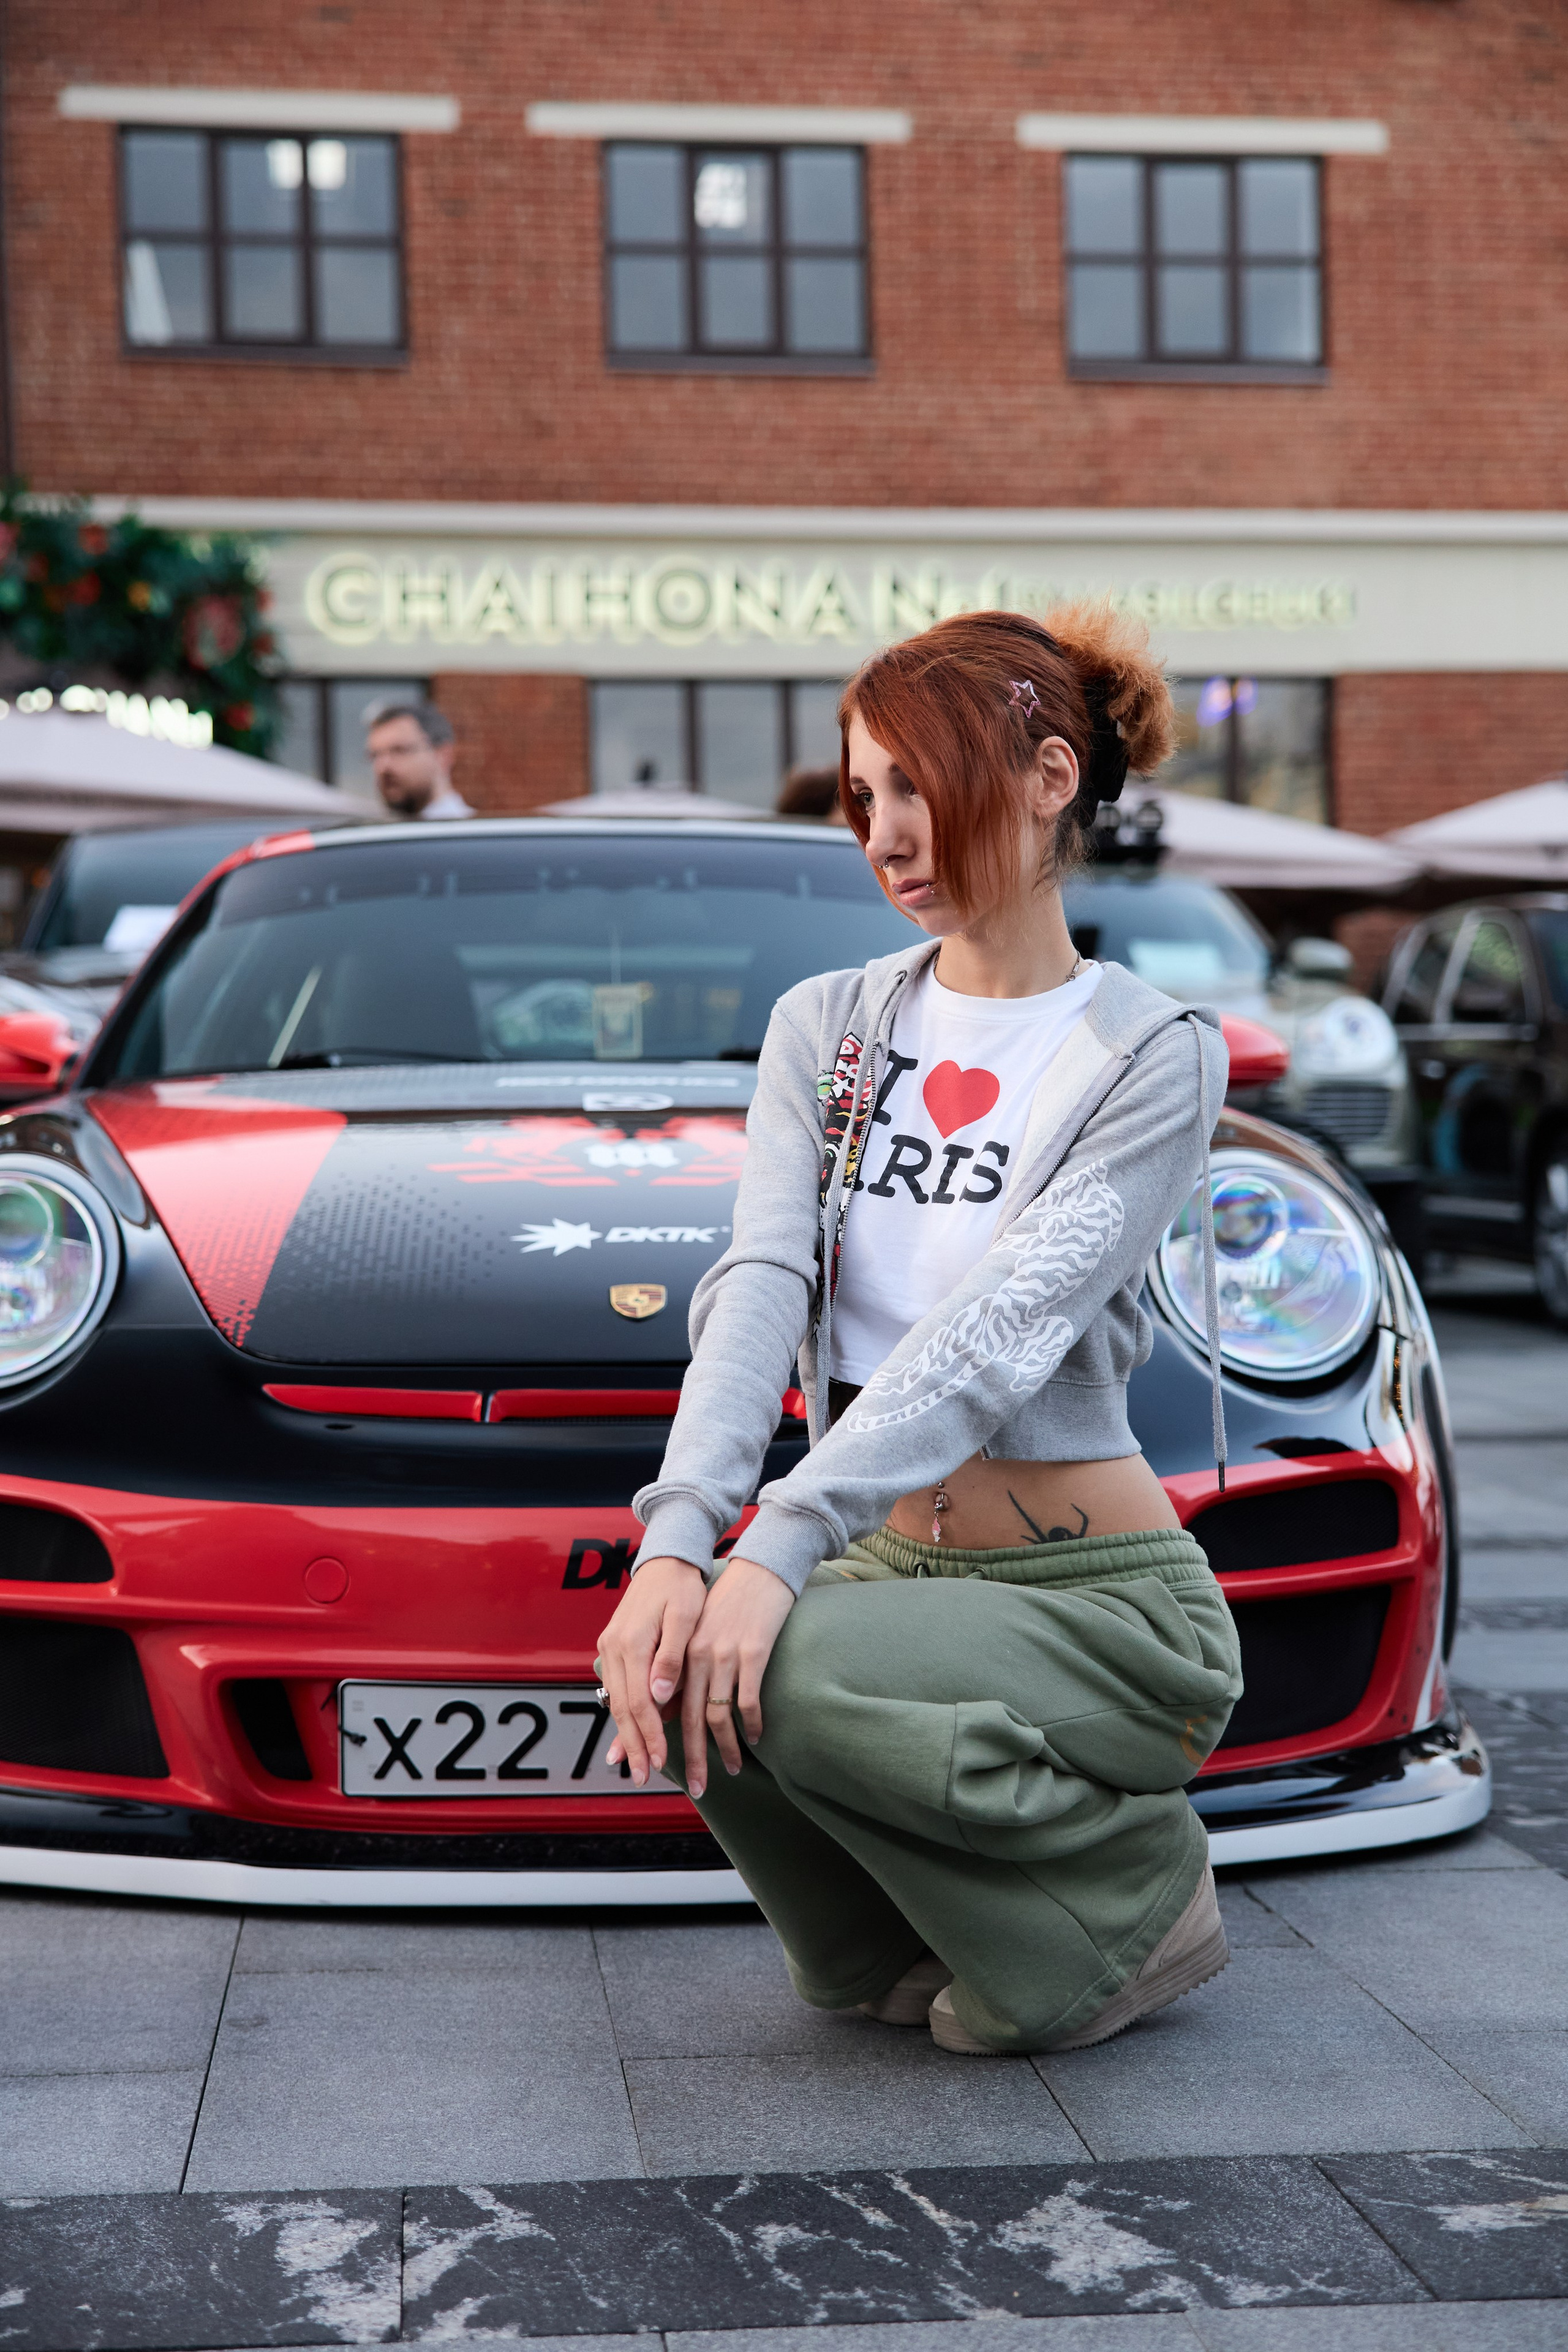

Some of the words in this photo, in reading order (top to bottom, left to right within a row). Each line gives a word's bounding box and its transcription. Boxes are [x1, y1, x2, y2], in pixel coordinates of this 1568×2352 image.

[308, 553, 862, 645] CHAIHONA
[869, 1049, 919, 1126] I
[850, 1134, 1009, 1204] RIS
[605, 1226, 718, 1243] DKTK
[374, 1700, 631, 1780] X227
